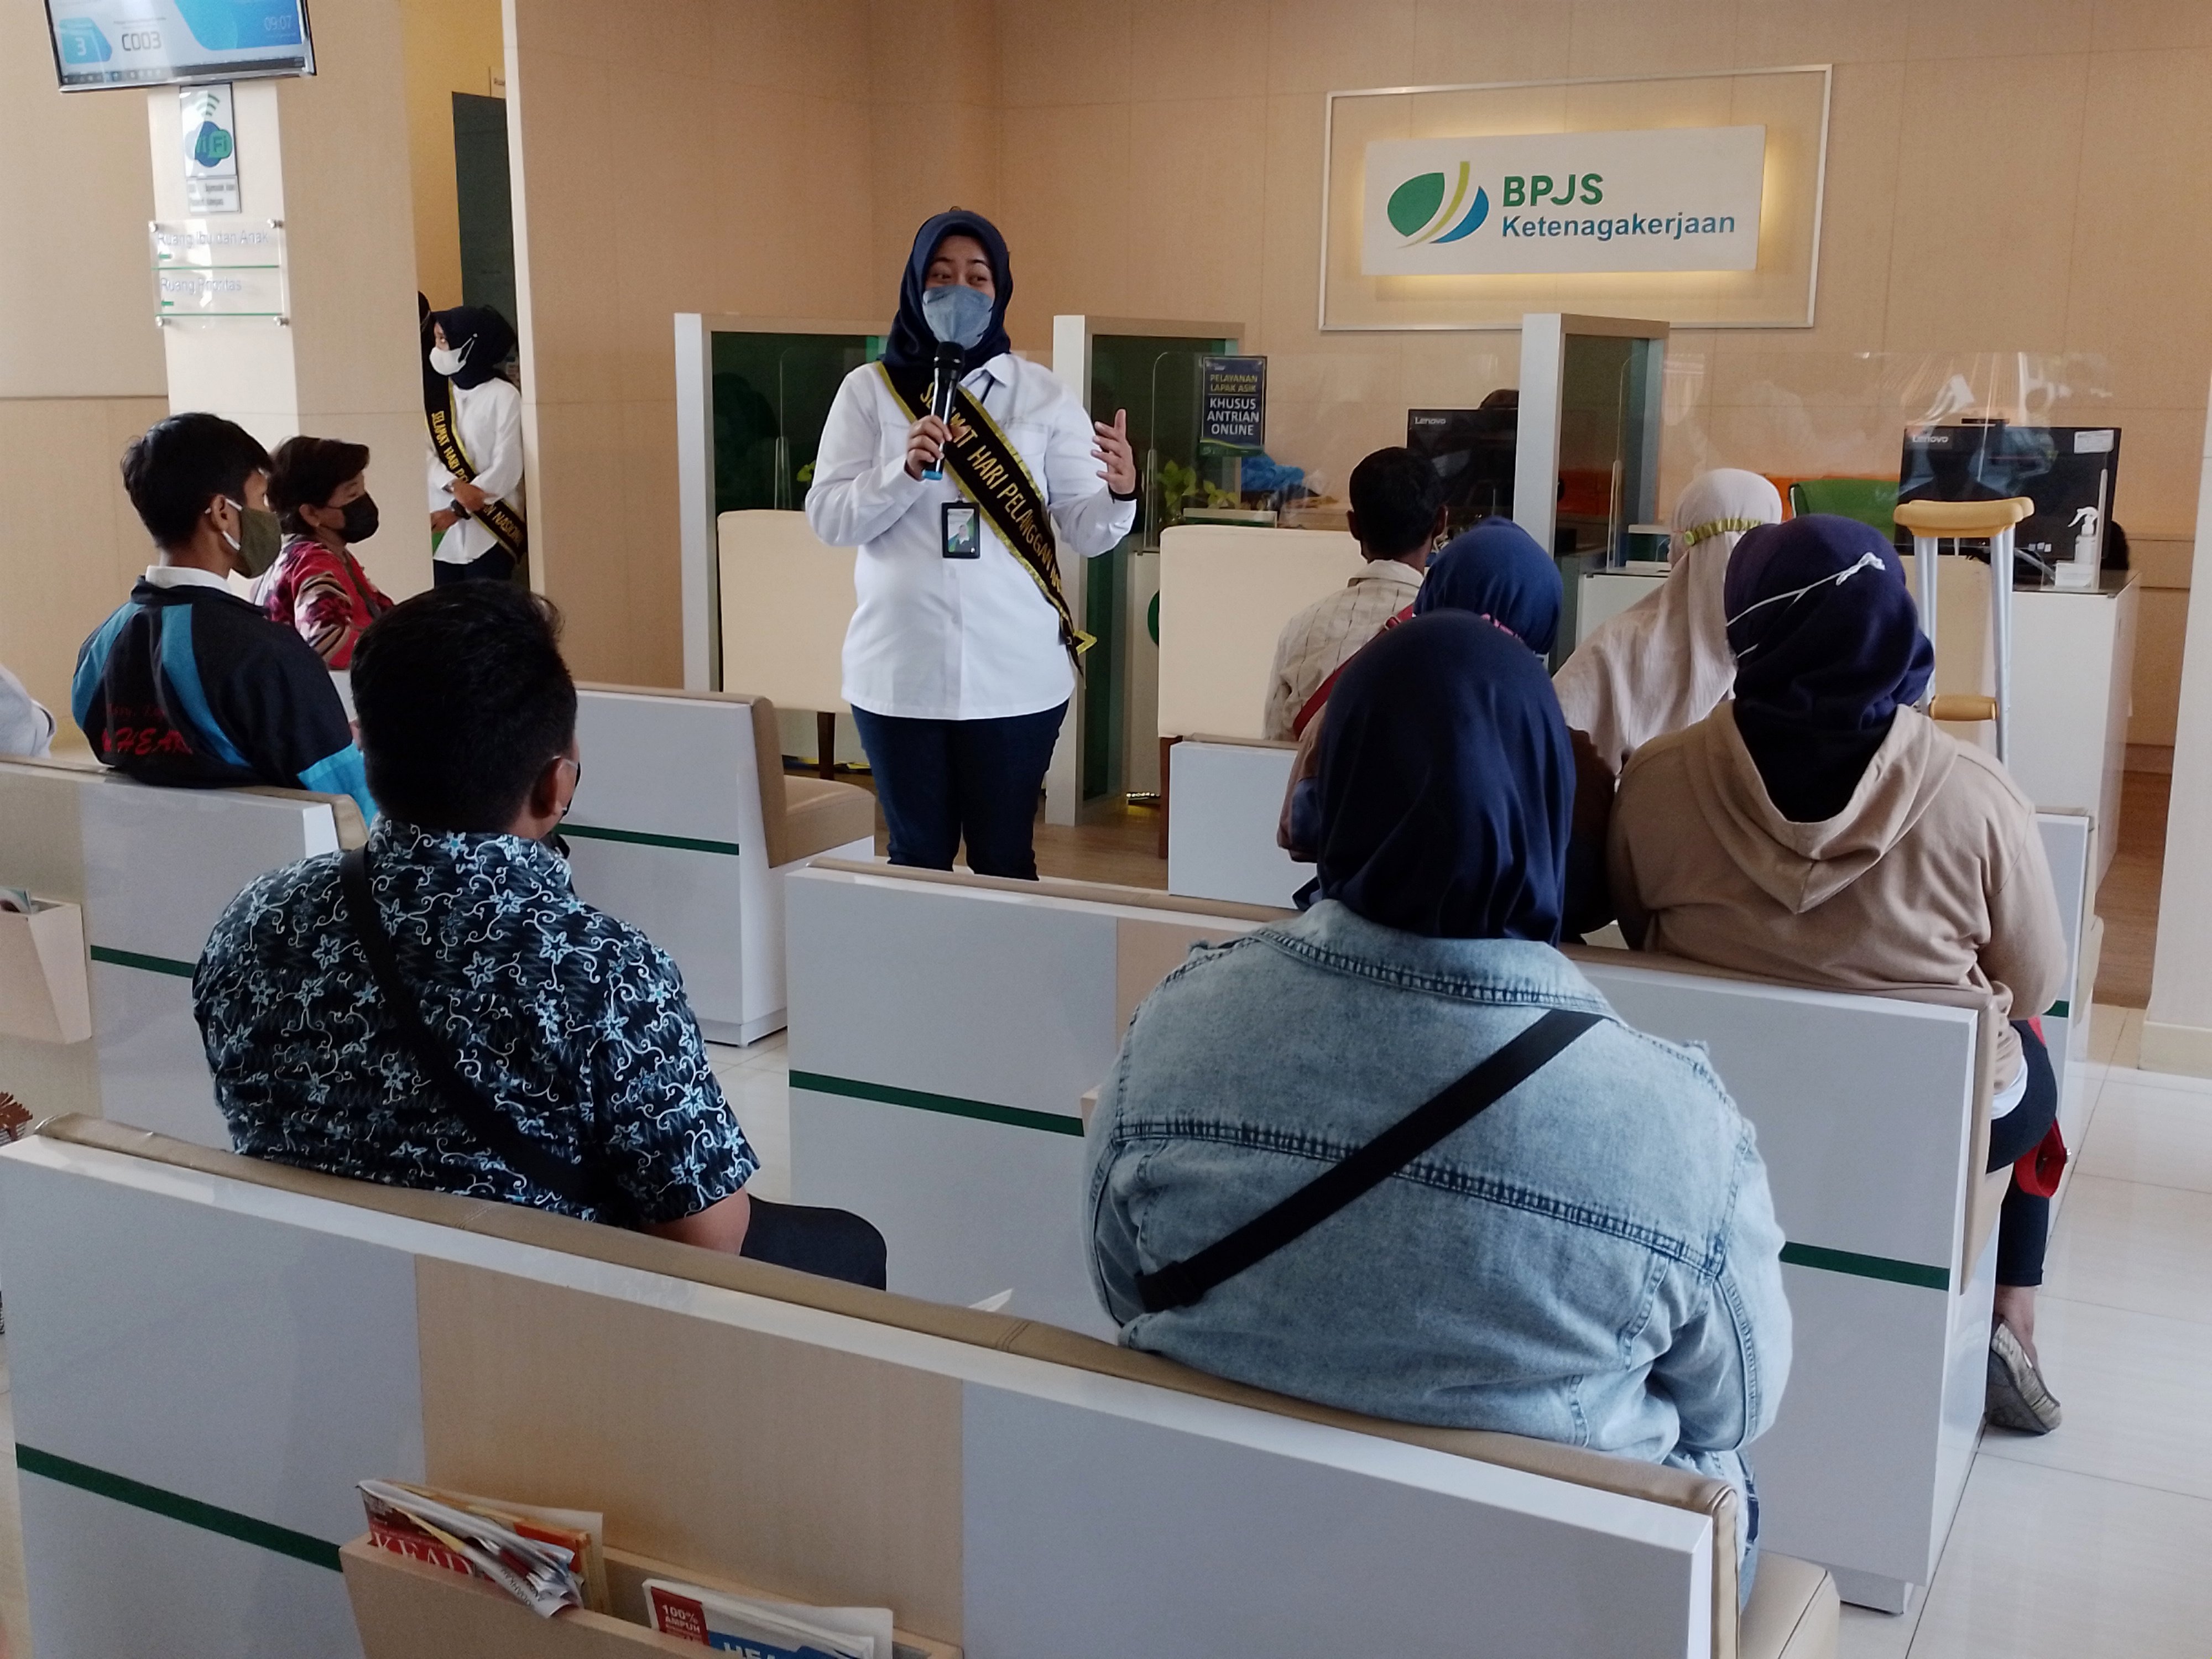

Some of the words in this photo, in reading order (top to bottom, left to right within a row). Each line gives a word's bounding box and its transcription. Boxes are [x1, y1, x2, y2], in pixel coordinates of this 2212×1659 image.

[75, 38, 86, 55] 3
[1503, 173, 1604, 207] BPJS
[1502, 212, 1735, 241] Ketenagakerjaan
[157, 232, 193, 249] Ruang
[160, 278, 196, 296] Ruang
[1210, 374, 1258, 383] PELAYANAN
[1211, 383, 1235, 392] LAPAK
[1238, 384, 1256, 392] ASIK
[1209, 398, 1256, 410] KHUSUS
[1207, 410, 1260, 422] ANTRIAN
[1415, 416, 1447, 425] Lenovo
[1211, 424, 1254, 436] ONLINE
[443, 445, 460, 471] HARI
[967, 445, 1009, 490] HARI
[997, 482, 1053, 571] PELANGGAN
[662, 1604, 699, 1626] 100%
